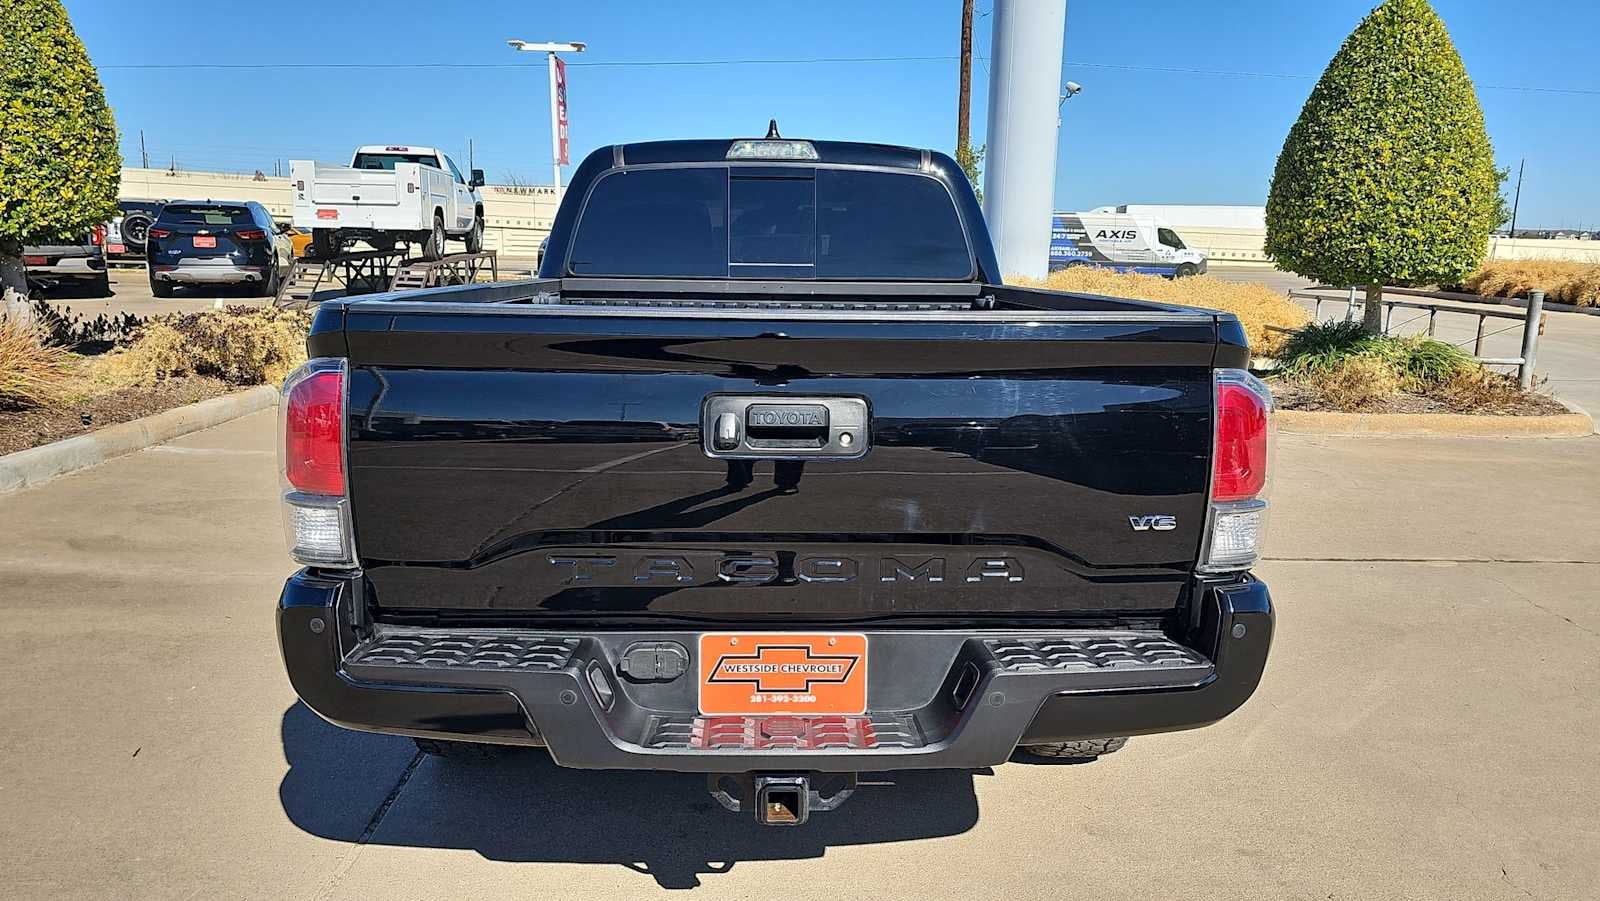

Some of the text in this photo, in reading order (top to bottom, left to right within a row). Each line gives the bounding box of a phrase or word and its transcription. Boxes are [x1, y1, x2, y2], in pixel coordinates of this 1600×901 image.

[506, 187, 556, 195] NEWMARK
[1096, 230, 1137, 239] AXIS
[753, 412, 822, 425] TOYOTA
[1128, 515, 1177, 531] V6
[546, 555, 1025, 583] TACOMA
[724, 664, 843, 673] WESTSIDE CHEVROLET
